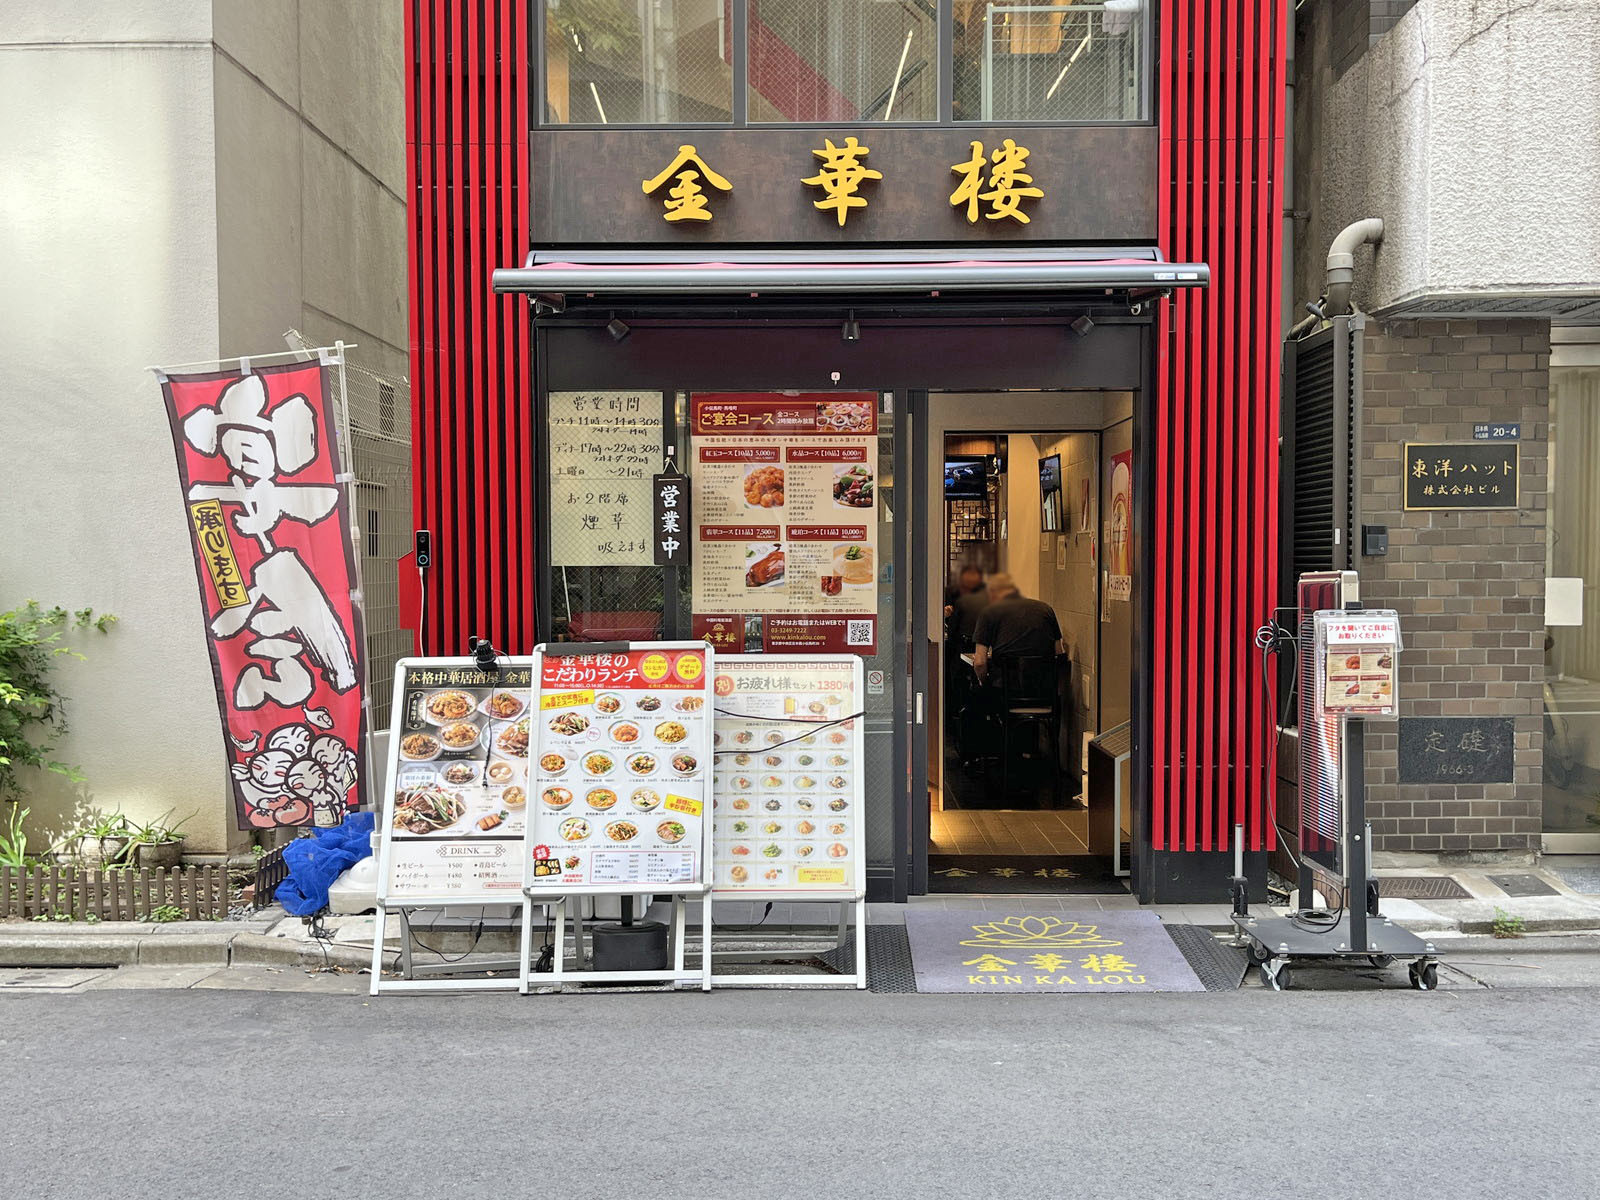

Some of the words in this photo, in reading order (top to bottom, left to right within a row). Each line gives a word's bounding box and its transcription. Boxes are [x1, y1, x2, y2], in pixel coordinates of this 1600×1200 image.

[642, 137, 1044, 226] 金華楼
[701, 412, 775, 426] ご宴会コース
[1493, 427, 1517, 437] 20-4
[1411, 458, 1513, 479] 東洋ハット
[1423, 484, 1500, 496] 株式会社ビル
[660, 484, 681, 560] 営業中
[543, 668, 639, 683] こだわりランチ
[1425, 729, 1488, 753] 定礎
[1436, 764, 1474, 775] 1966-3
[450, 847, 480, 855] DRINK
[961, 952, 1138, 973] 金華楼
[967, 975, 1023, 985] KIN
[1034, 975, 1077, 985] KA
[1087, 975, 1147, 985] LOU
